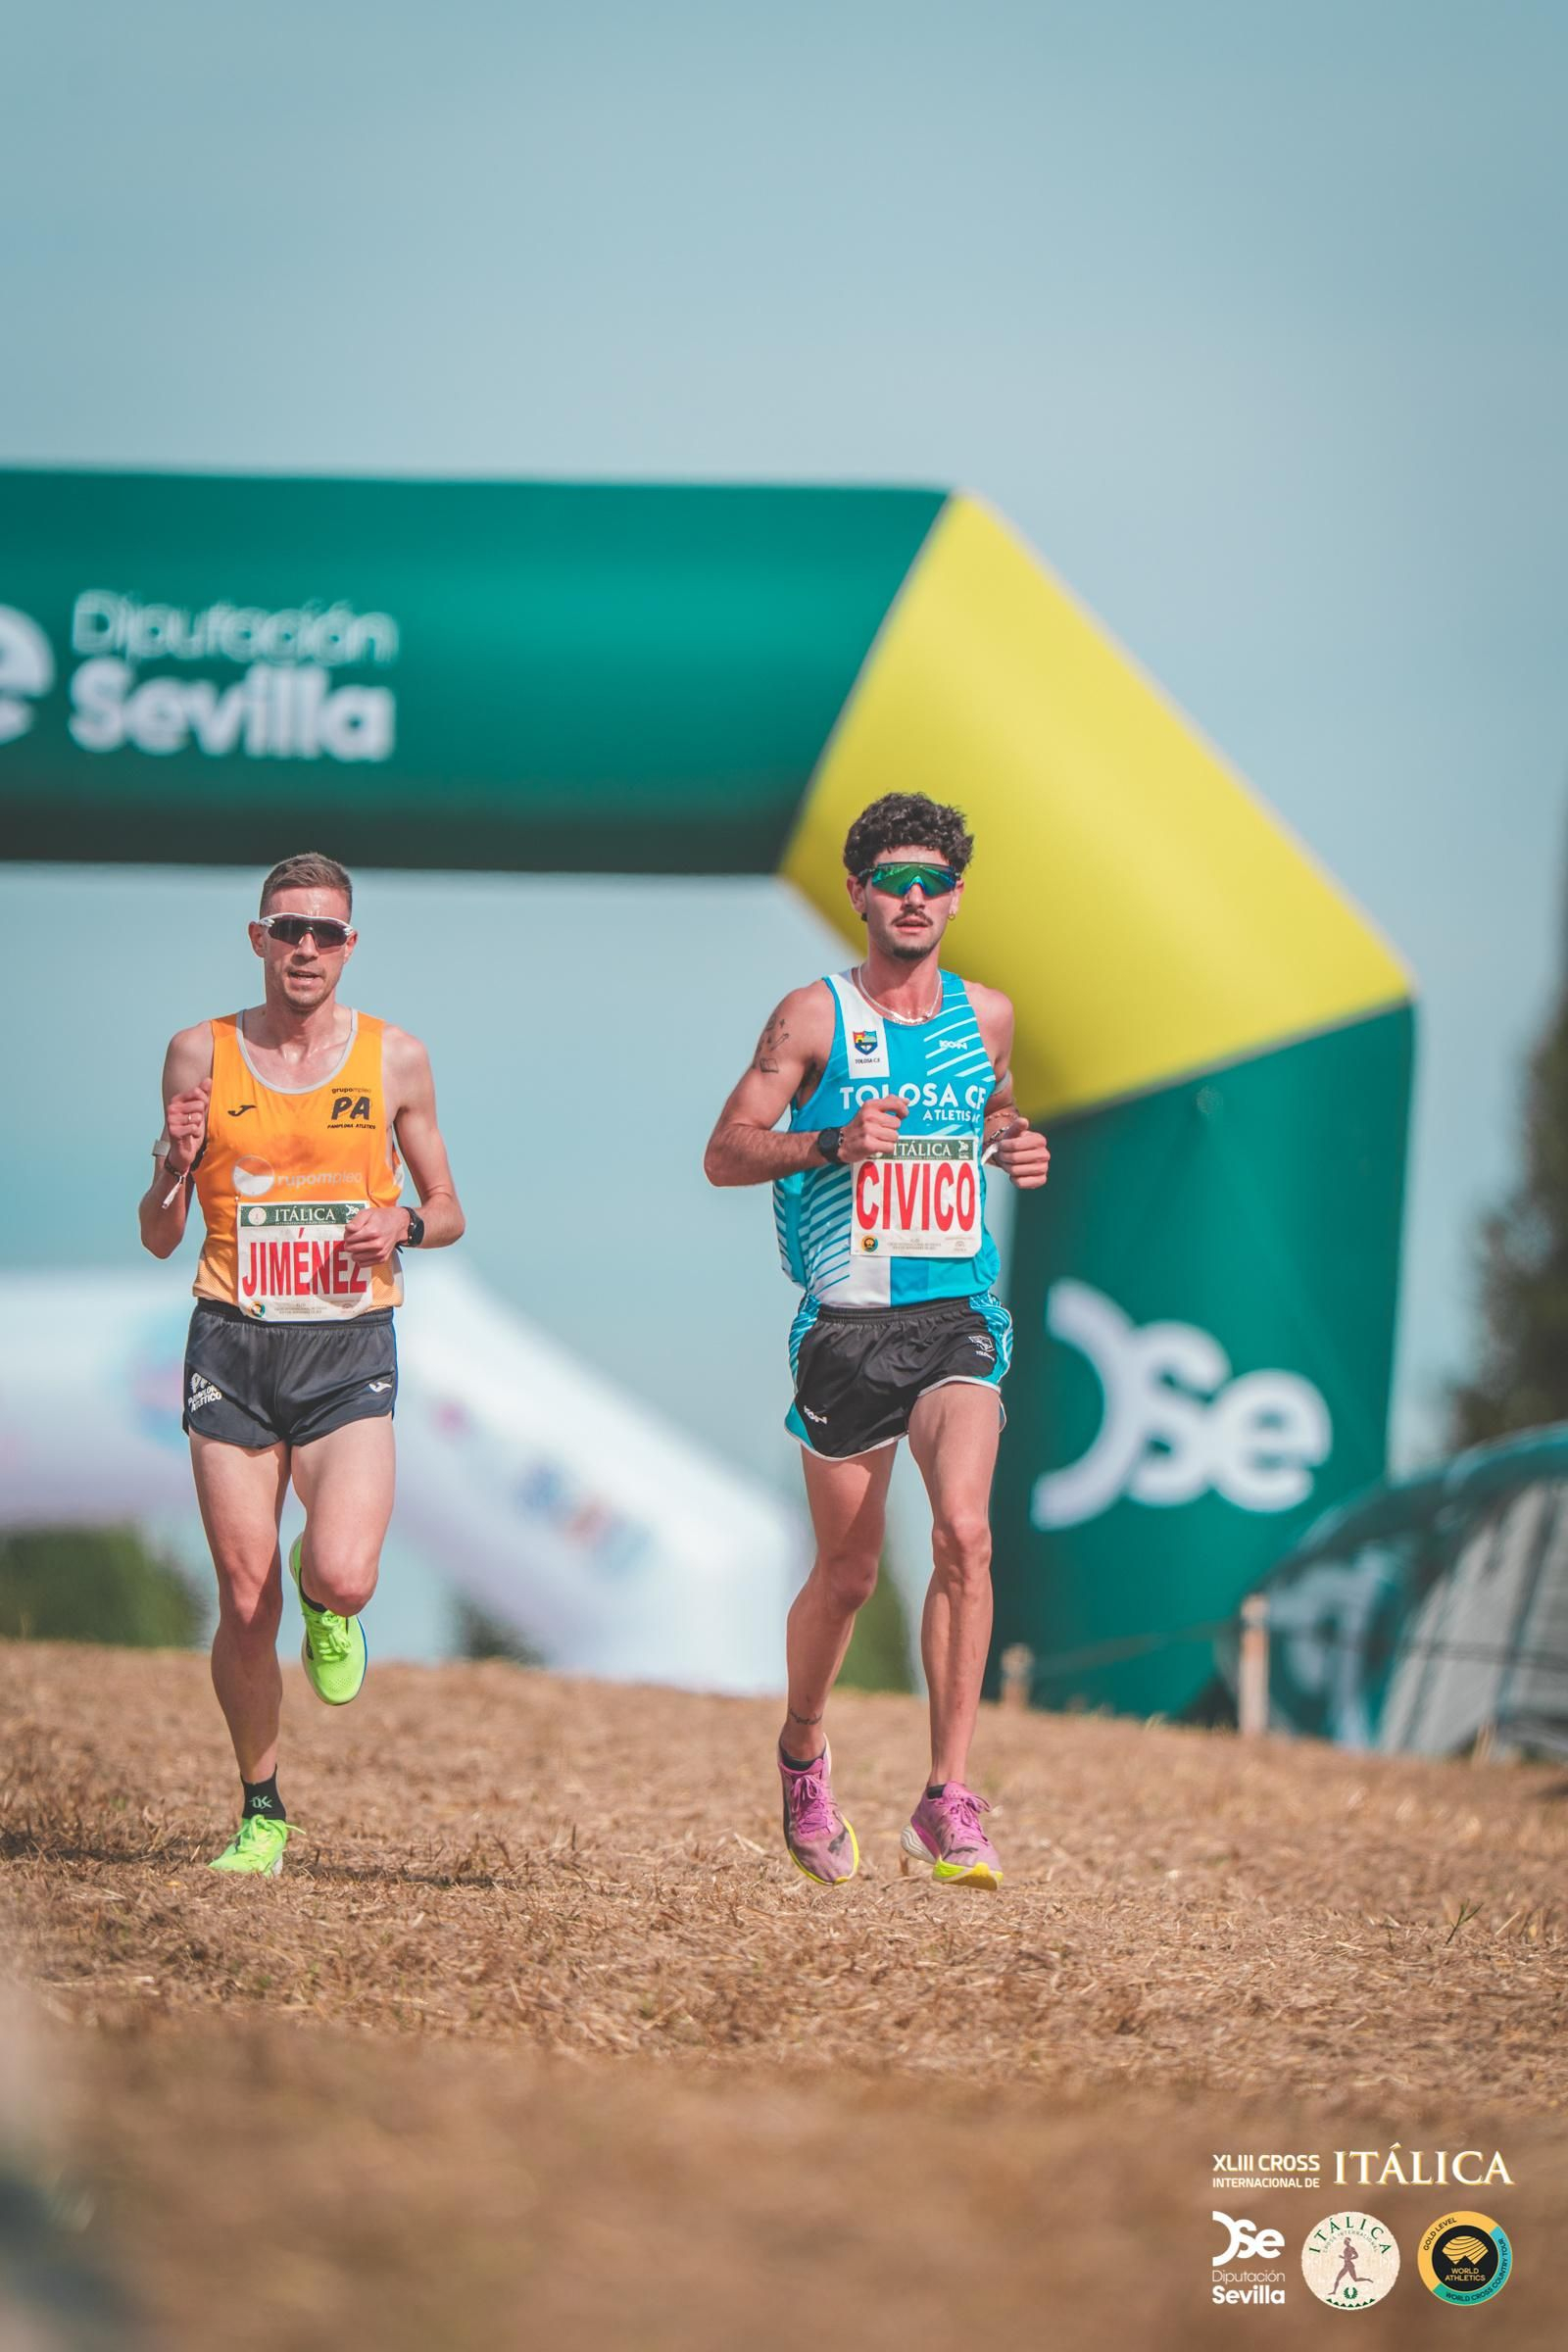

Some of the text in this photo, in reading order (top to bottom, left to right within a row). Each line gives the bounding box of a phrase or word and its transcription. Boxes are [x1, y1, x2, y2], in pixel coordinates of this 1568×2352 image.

[69, 656, 398, 762] Sevilla
[331, 1096, 370, 1120] PA
[893, 1141, 953, 1156] ITÁLICA
[274, 1205, 335, 1222] ITÁLICA
[857, 1161, 975, 1232] CIVICO
[242, 1226, 368, 1297] JIMÉNEZ
